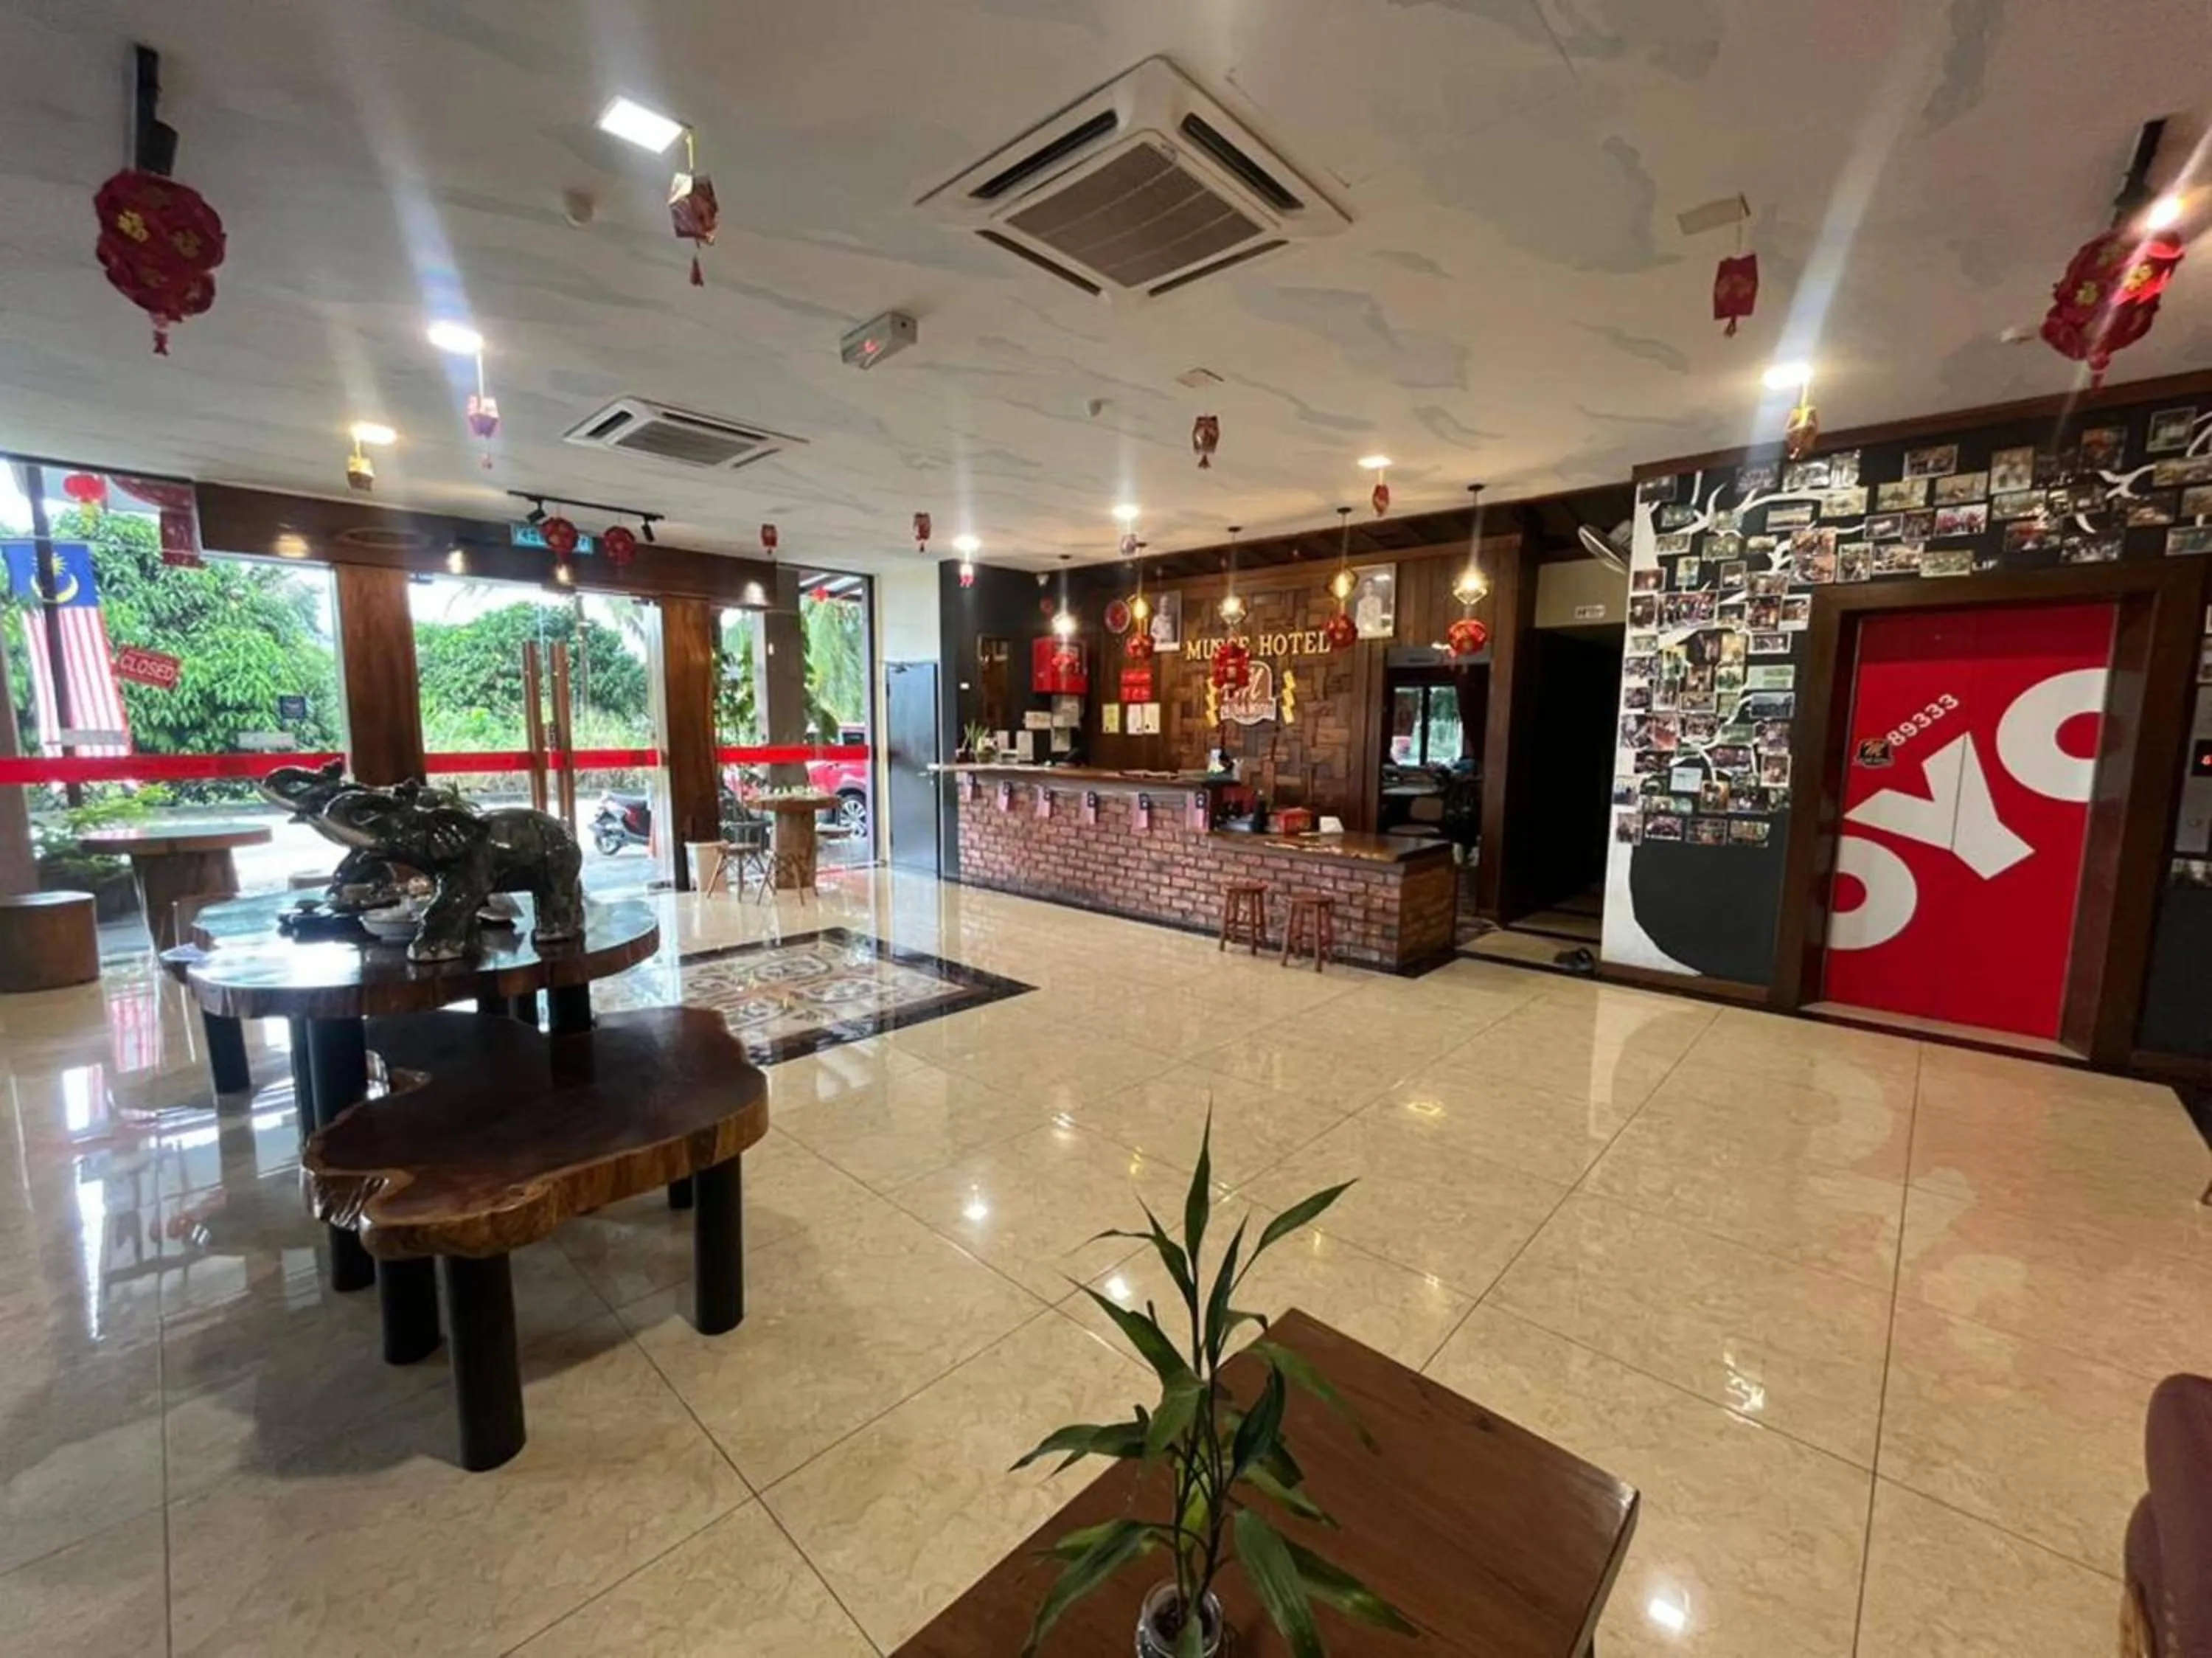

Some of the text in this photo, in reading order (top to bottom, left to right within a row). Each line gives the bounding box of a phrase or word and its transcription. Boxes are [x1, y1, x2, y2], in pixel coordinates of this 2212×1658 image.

[1259, 631, 1330, 656] HOTEL
[120, 654, 175, 680] CLOSED
[1885, 693, 1959, 746] 89333
